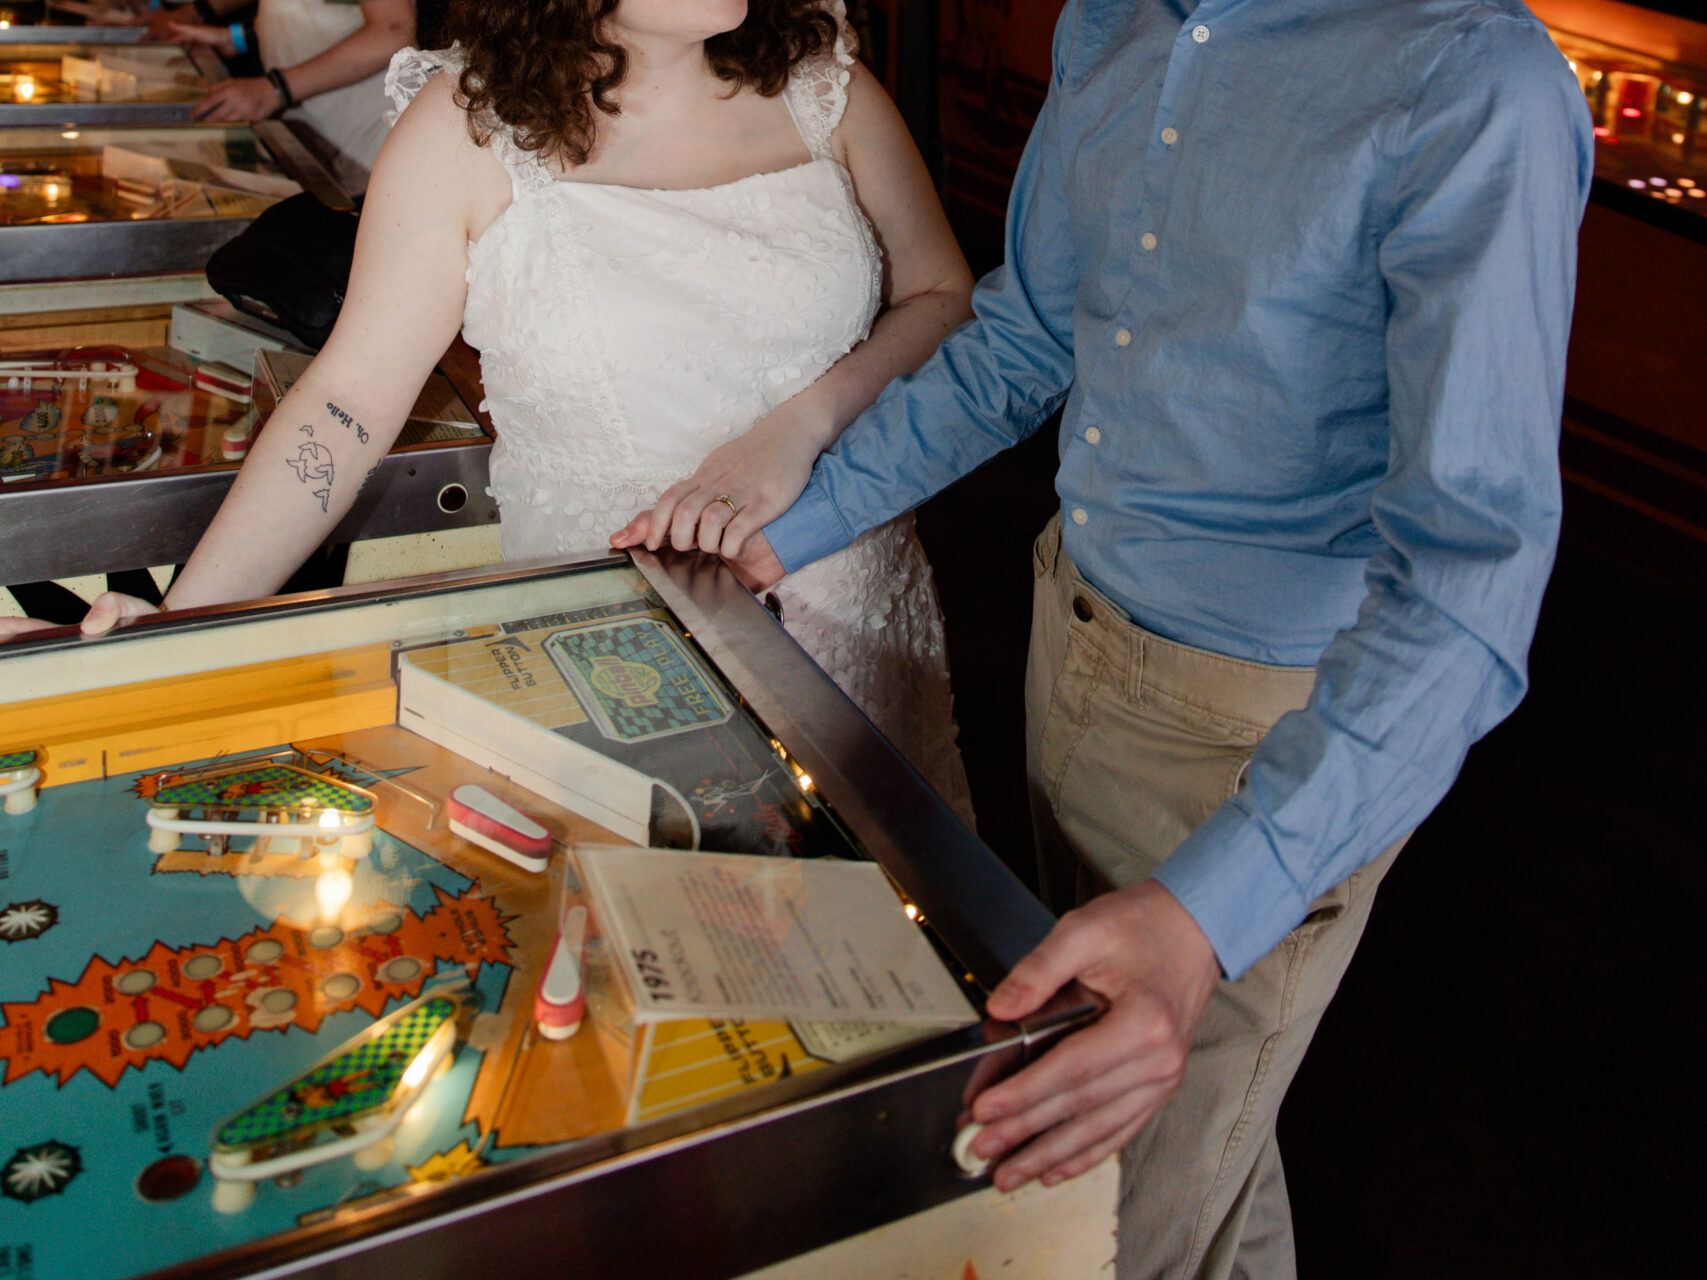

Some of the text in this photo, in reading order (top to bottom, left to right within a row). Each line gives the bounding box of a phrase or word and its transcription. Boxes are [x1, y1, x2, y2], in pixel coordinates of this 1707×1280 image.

[326, 402, 354, 429] Hello
[490, 647, 521, 690] FLIPPER
[508, 645, 538, 688] BUTTON
[593, 656, 649, 707] pinball
[638, 629, 710, 717] FREE PLAY
[631, 947, 676, 1004] 1975
